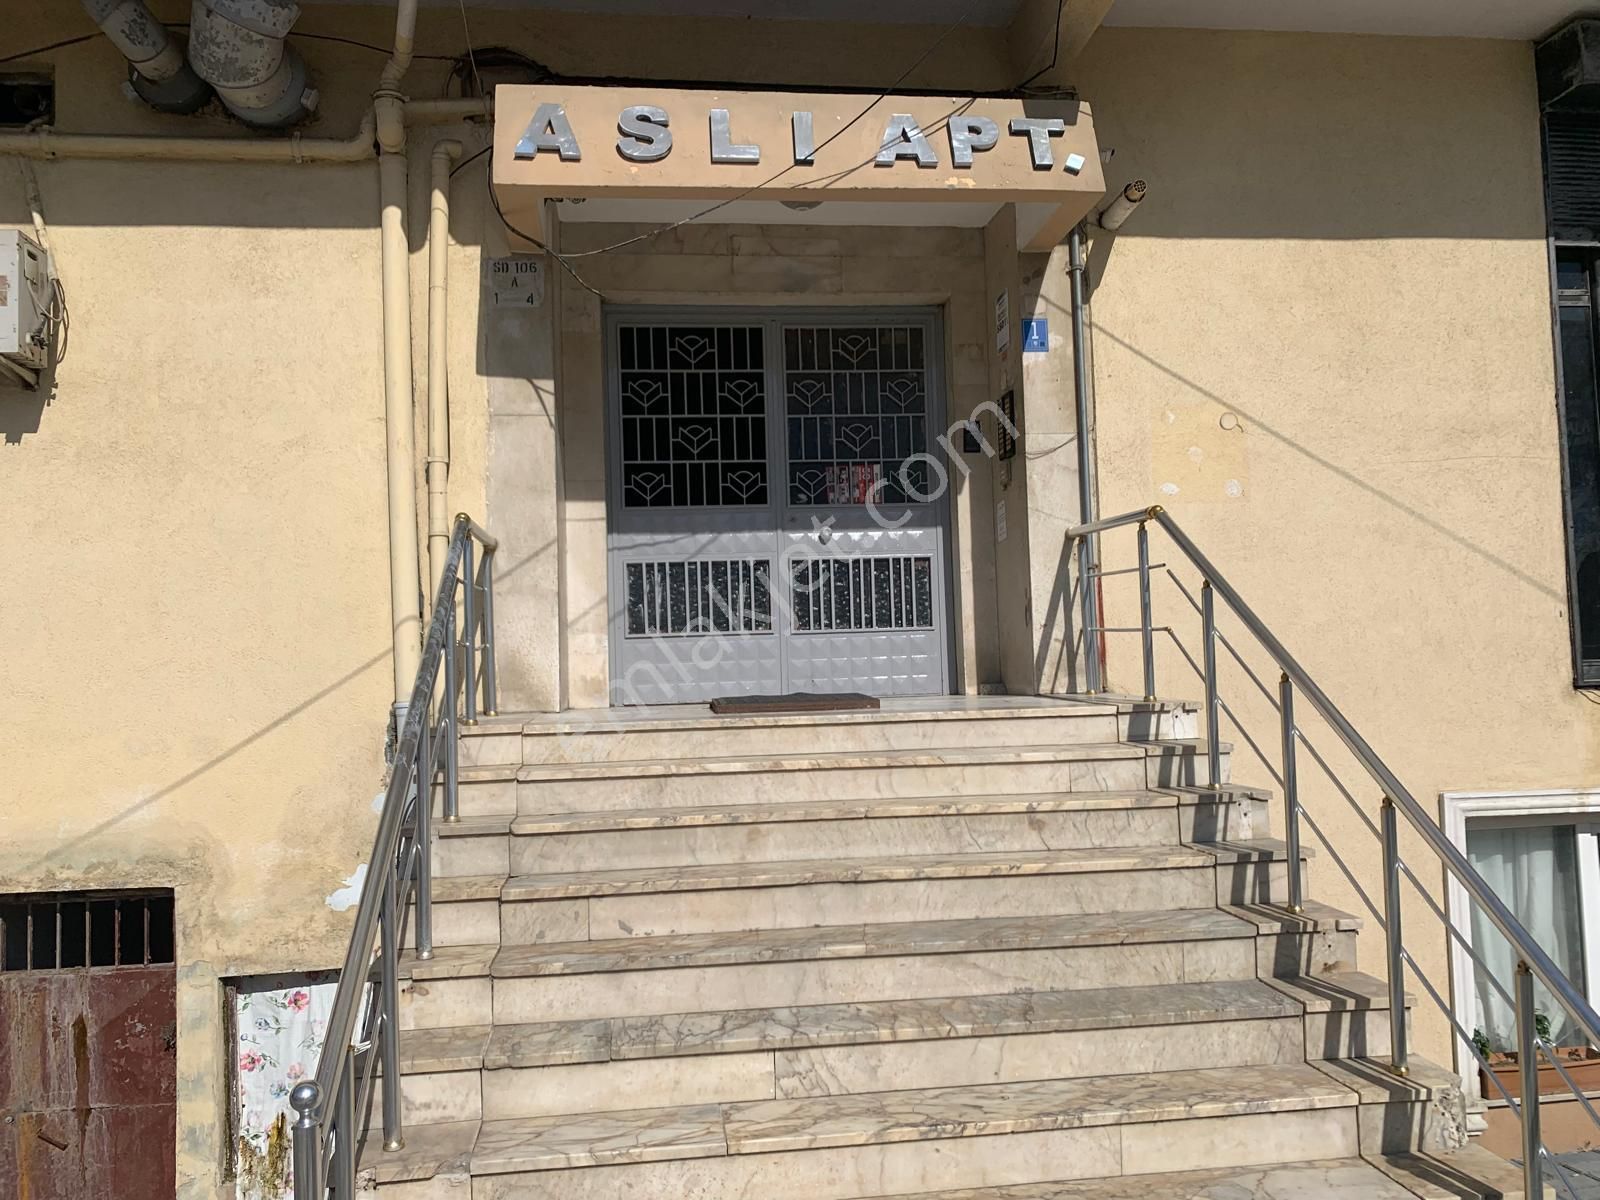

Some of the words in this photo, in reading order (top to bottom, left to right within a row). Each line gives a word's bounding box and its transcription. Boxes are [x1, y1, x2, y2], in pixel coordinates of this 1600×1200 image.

[513, 102, 814, 165] ASLI
[873, 112, 1085, 174] APT.
[515, 262, 537, 273] 106
[494, 292, 499, 304] 1
[526, 292, 534, 305] 4
[1031, 321, 1039, 339] 1
